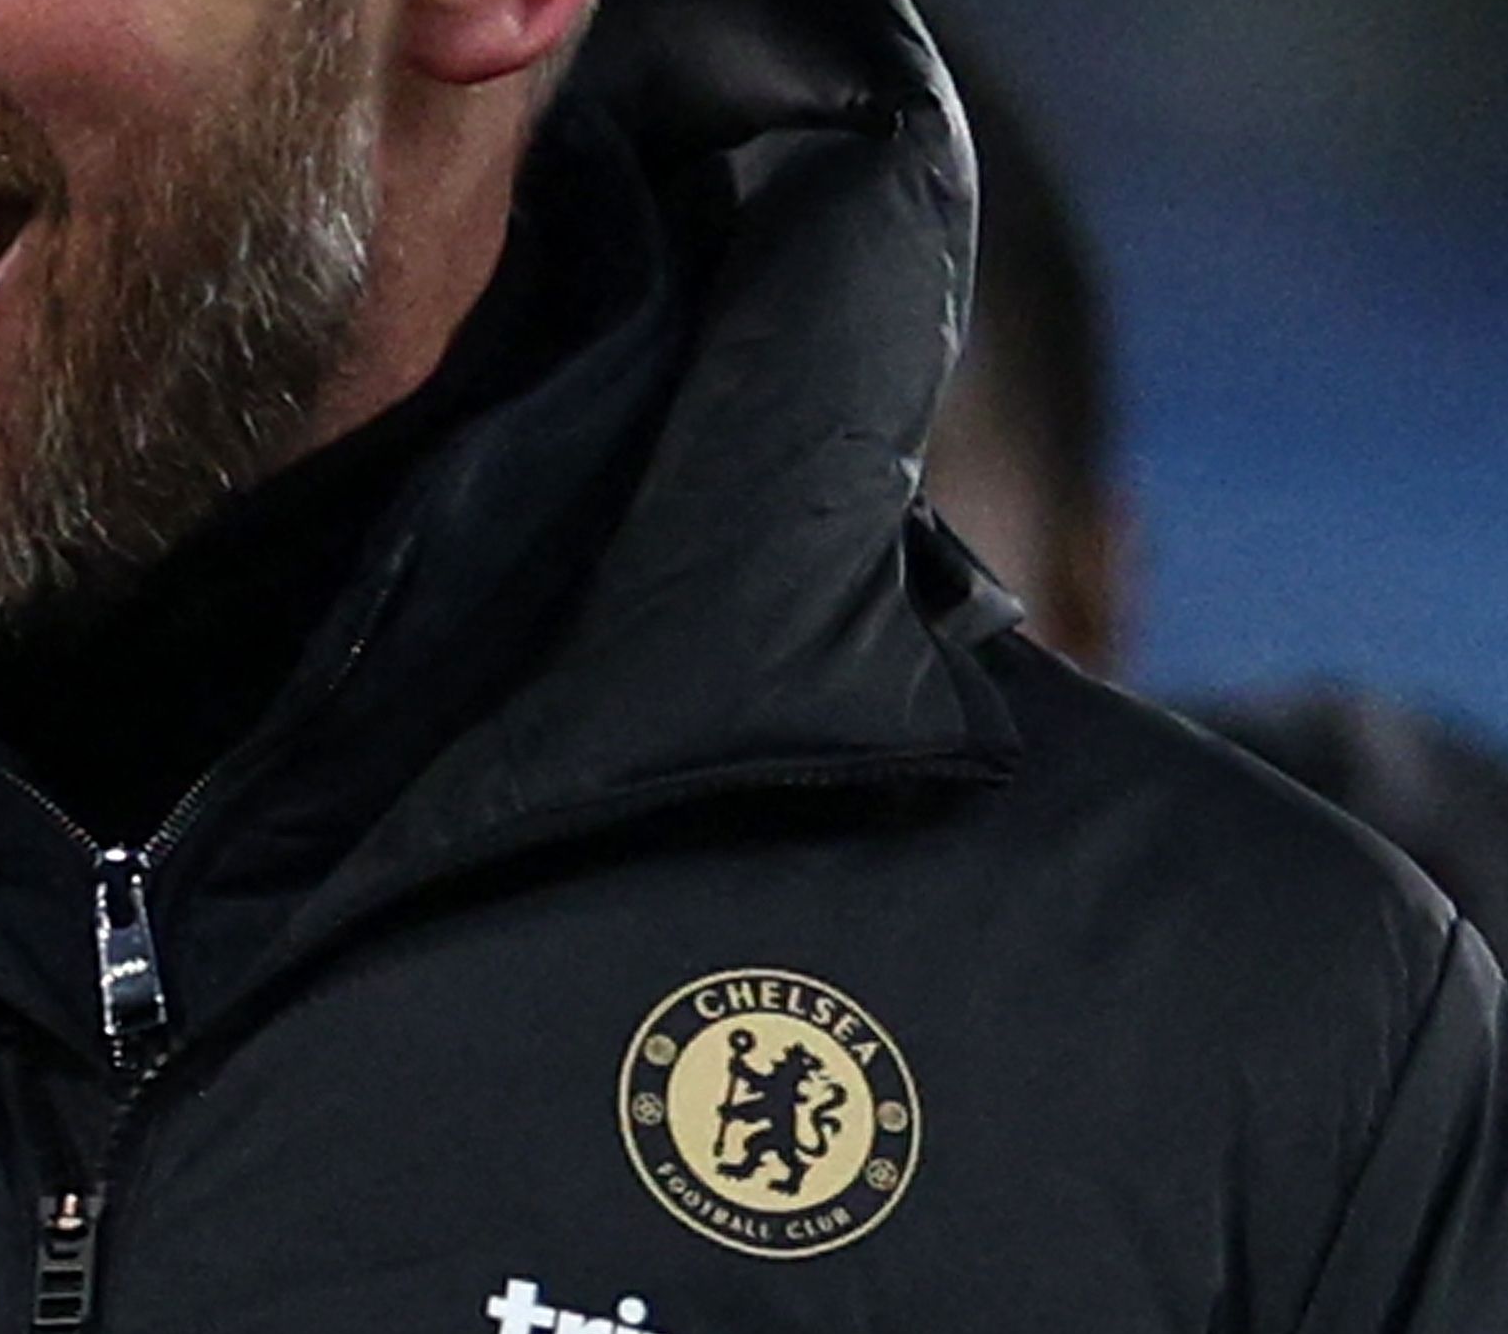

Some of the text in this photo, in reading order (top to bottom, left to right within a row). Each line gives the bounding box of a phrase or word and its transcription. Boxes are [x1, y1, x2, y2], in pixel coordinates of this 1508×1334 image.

[692, 979, 881, 1066] CHELSEA
[656, 1161, 853, 1242] FOOTBALL CLUB
